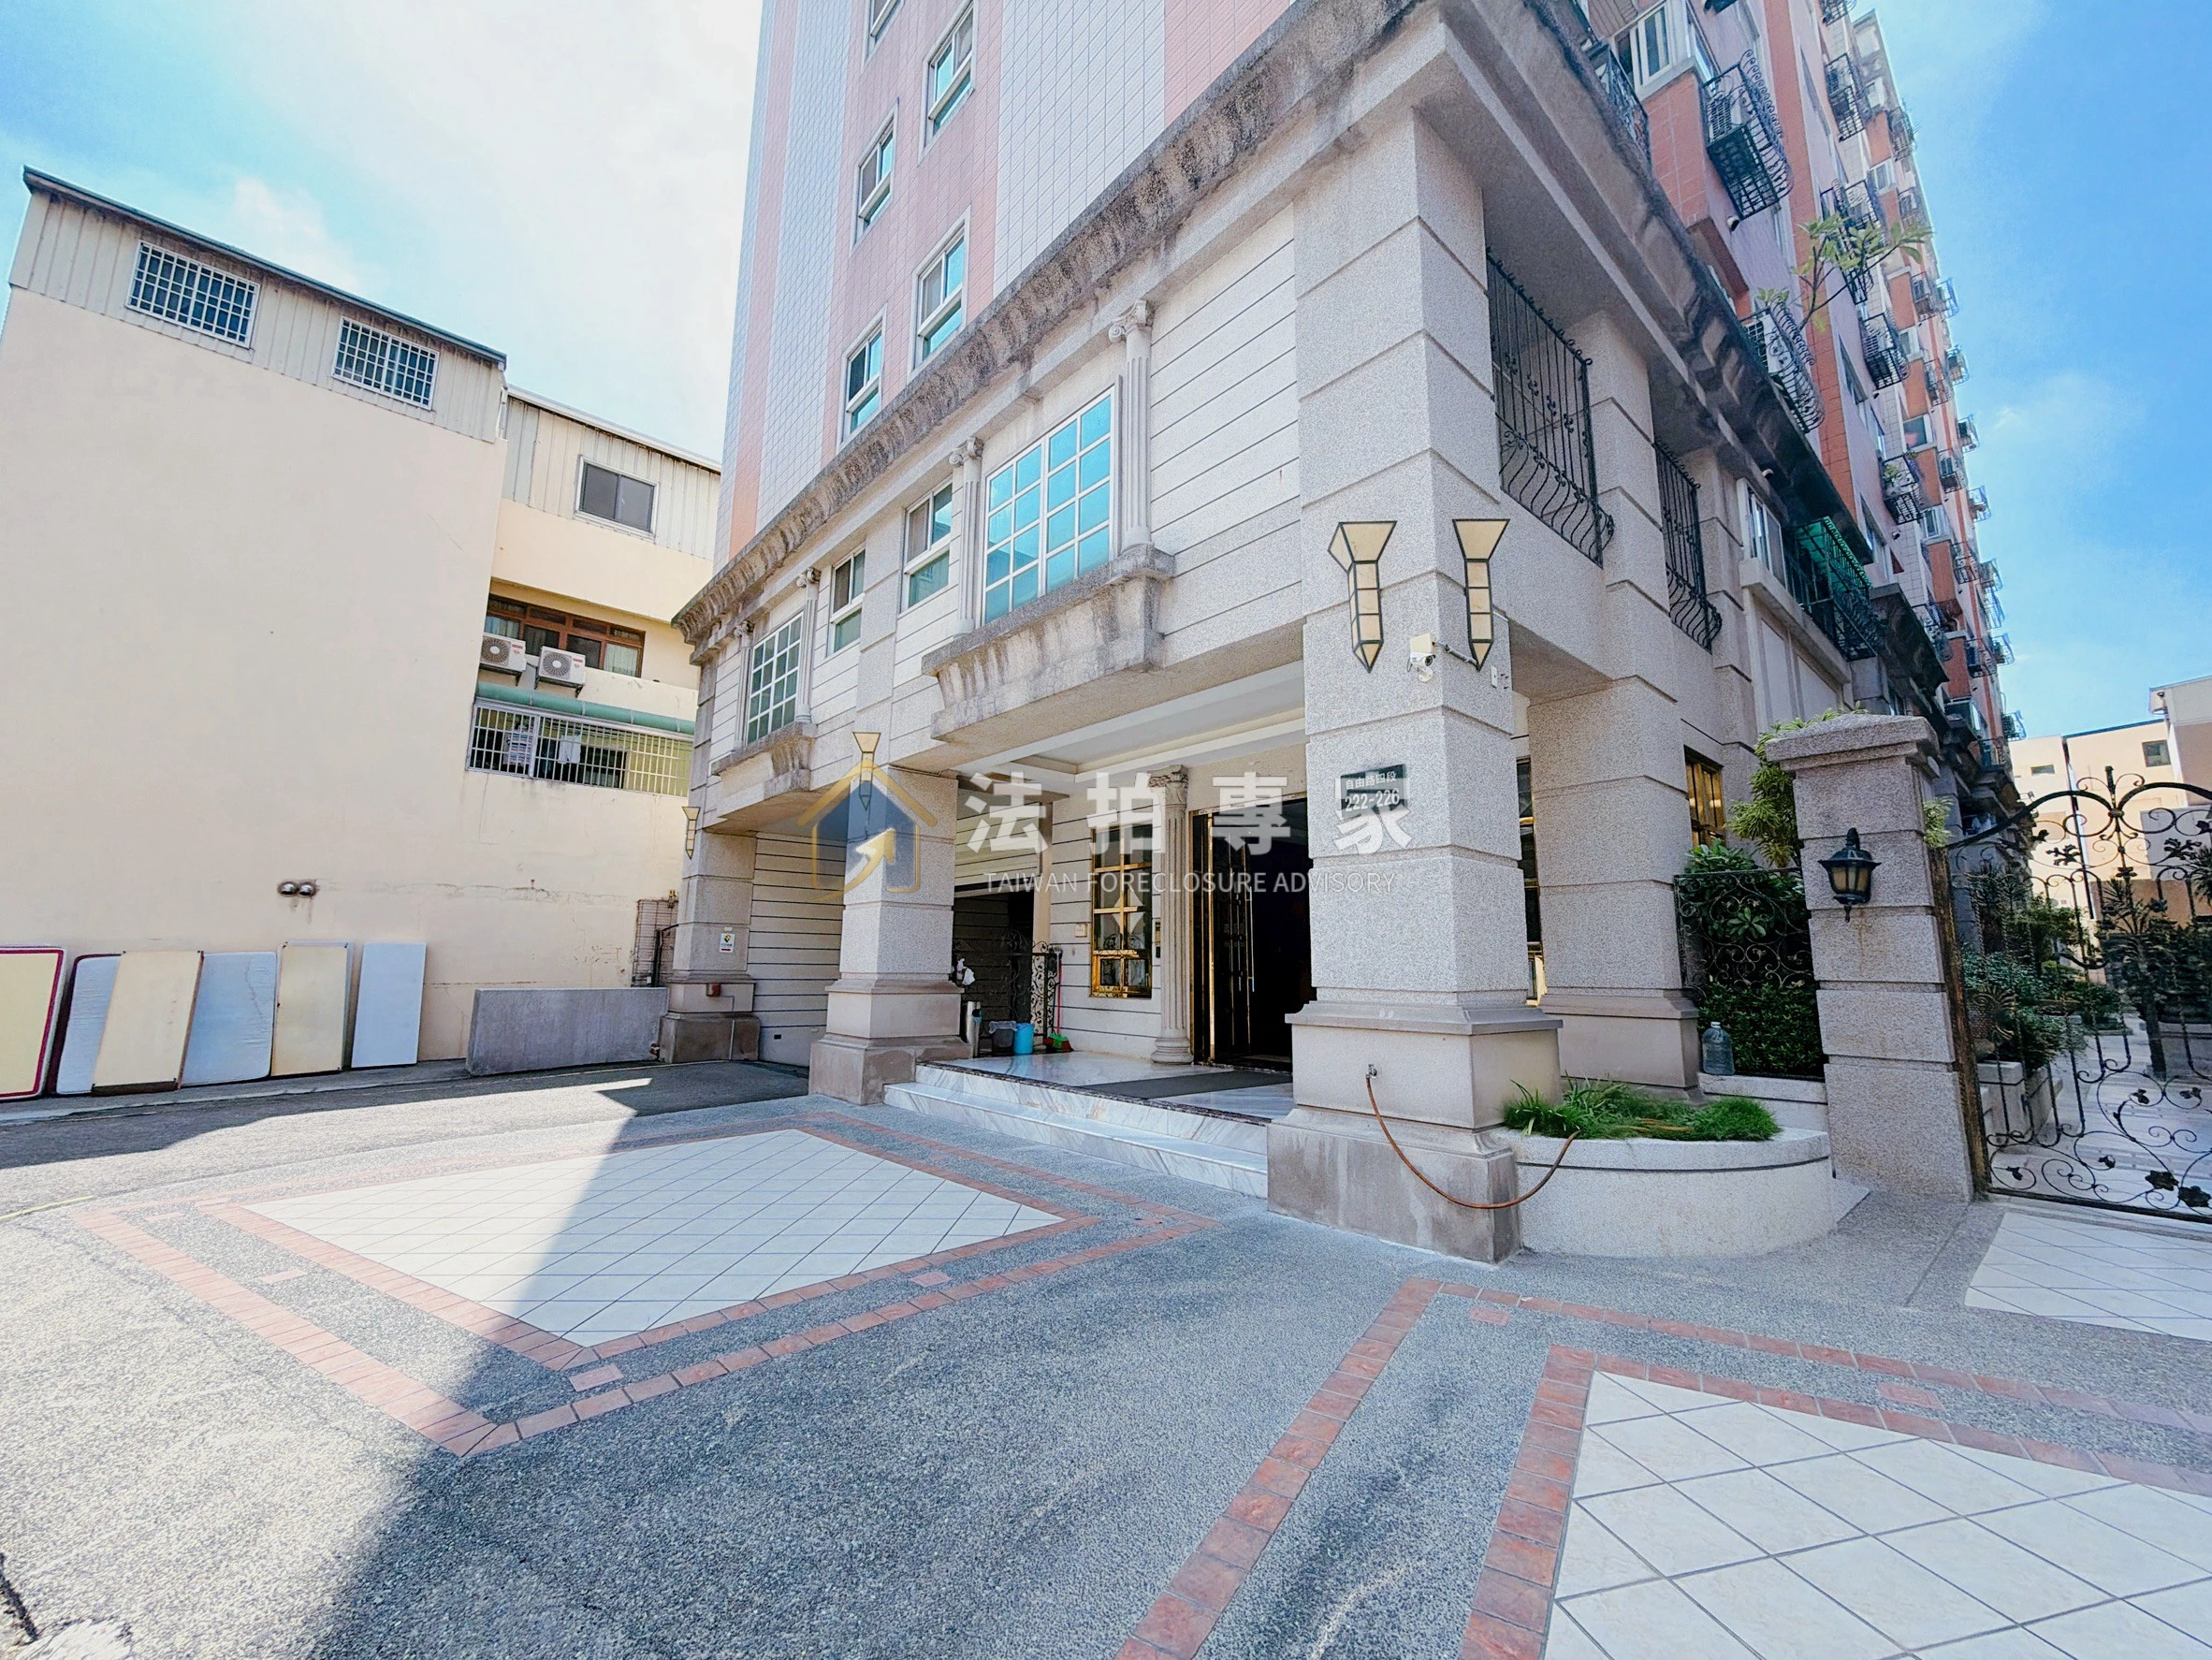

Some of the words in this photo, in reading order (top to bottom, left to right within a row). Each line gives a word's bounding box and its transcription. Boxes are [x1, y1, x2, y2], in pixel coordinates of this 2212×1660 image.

[1346, 771, 1397, 790] 自由路四段
[1345, 787, 1400, 812] 222-226
